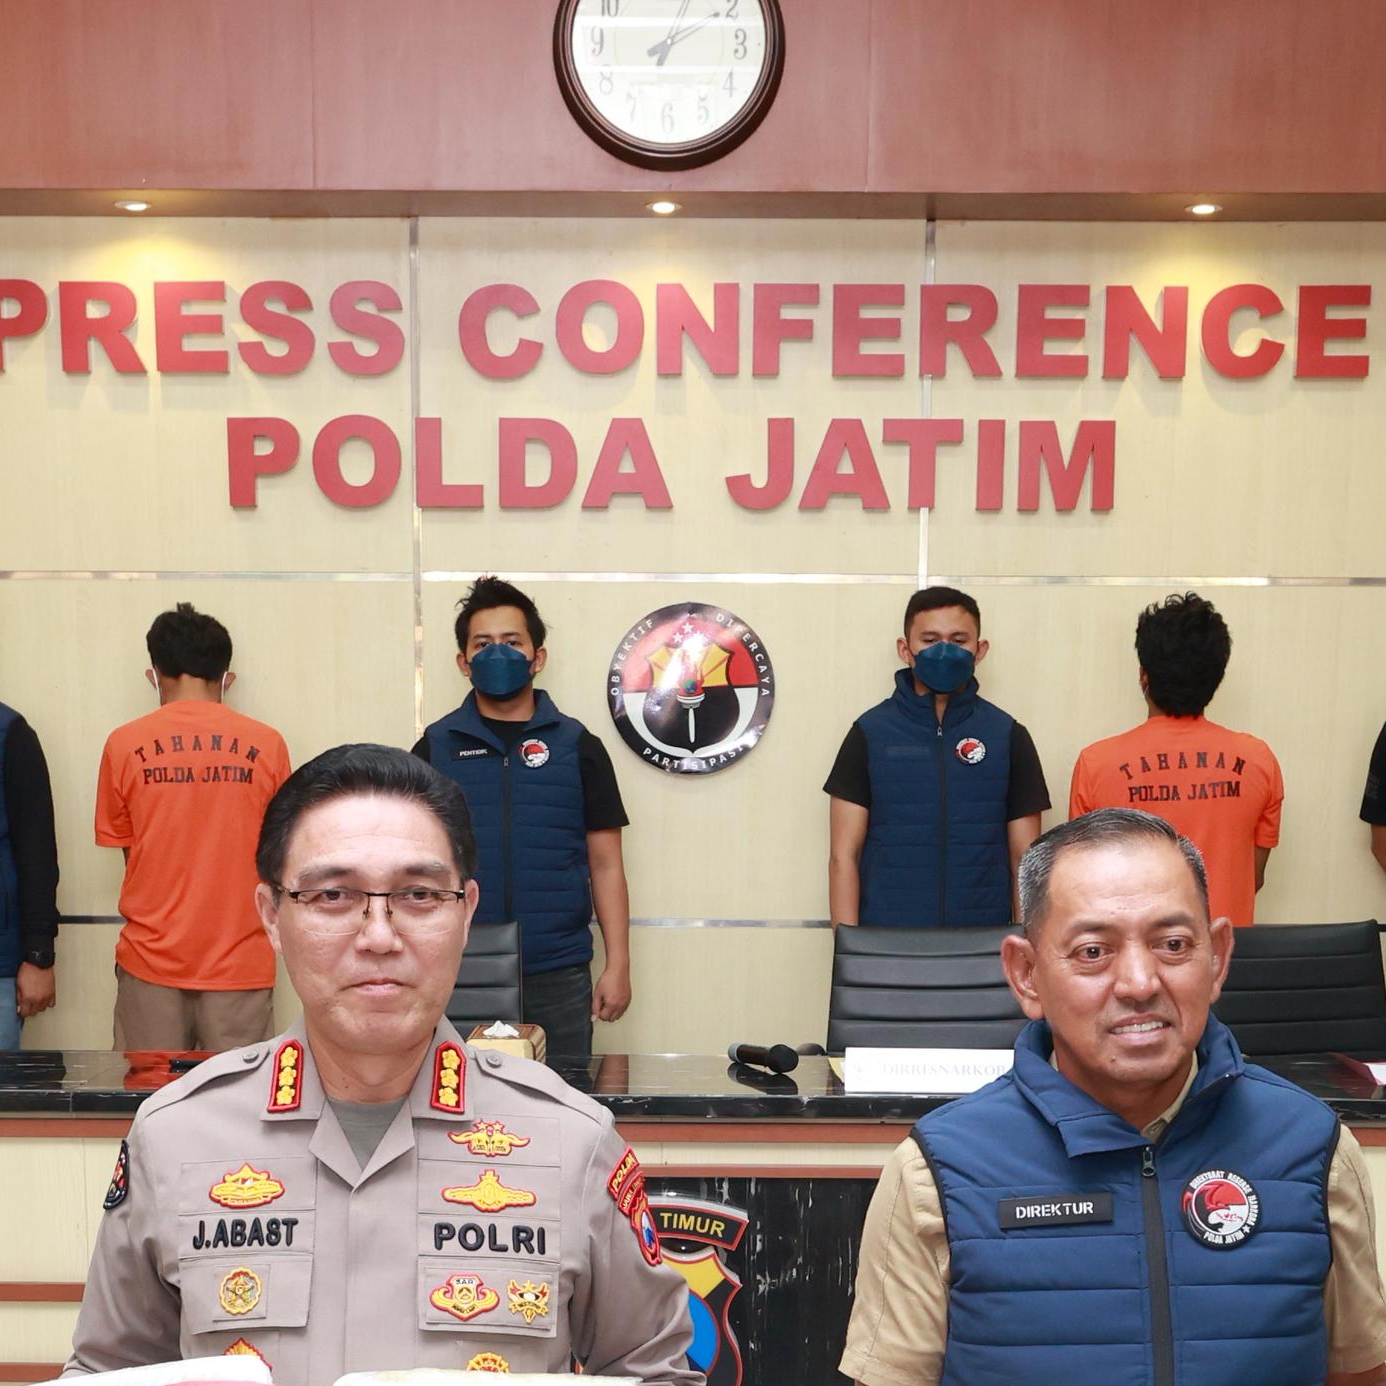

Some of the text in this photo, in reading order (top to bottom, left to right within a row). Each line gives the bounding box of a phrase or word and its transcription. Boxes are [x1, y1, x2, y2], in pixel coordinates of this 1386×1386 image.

[591, 27, 604, 56] 9
[734, 28, 747, 60] 3
[723, 70, 736, 98] 4
[457, 281, 1373, 380] CONFERENCE
[226, 416, 1118, 513] POLDA JATIM
[611, 613, 770, 696] OBYEKTIF DIPERCAYA
[135, 735, 260, 763] TAHANAN
[143, 766, 254, 784] POLDA JATIM
[1119, 752, 1246, 780] TAHANAN
[1128, 781, 1241, 802] POLDA JATIM
[883, 1063, 1007, 1076] DIRRESNARKOB
[1016, 1202, 1093, 1219] DIREKTUR
[193, 1217, 299, 1250] J.ABAST
[434, 1222, 546, 1255] POLRI
[660, 1212, 725, 1238] TIMUR
